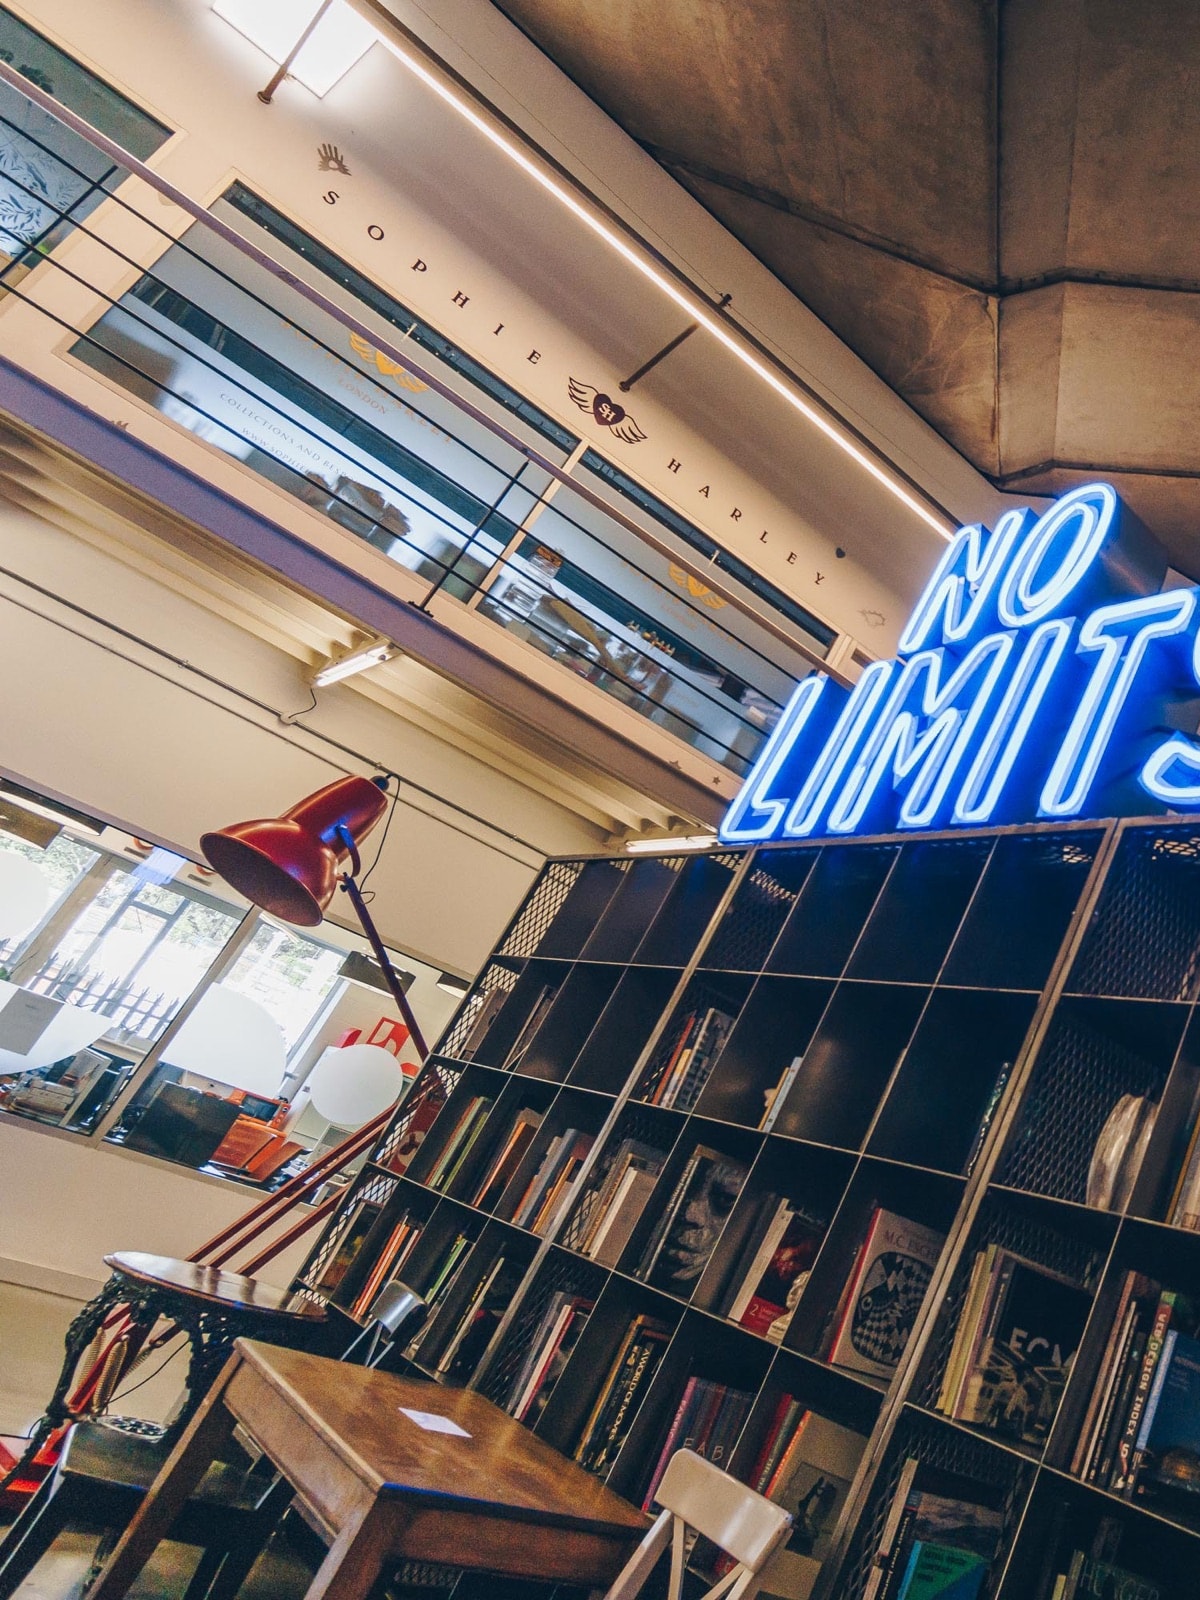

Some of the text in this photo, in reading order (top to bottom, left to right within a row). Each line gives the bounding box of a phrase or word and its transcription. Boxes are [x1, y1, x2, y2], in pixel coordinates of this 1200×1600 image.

[322, 189, 826, 585] SOPHIE HARLEY
[337, 374, 388, 415] LONDON
[220, 393, 295, 445] COLLECTIONS
[297, 443, 321, 461] AND
[899, 482, 1118, 655] NO
[1153, 1313, 1167, 1336] WEB
[629, 1355, 649, 1391] WORLD
[1139, 1342, 1158, 1391] DESIGN
[1126, 1395, 1144, 1436] INDEX
[683, 1437, 731, 1461] FAB
